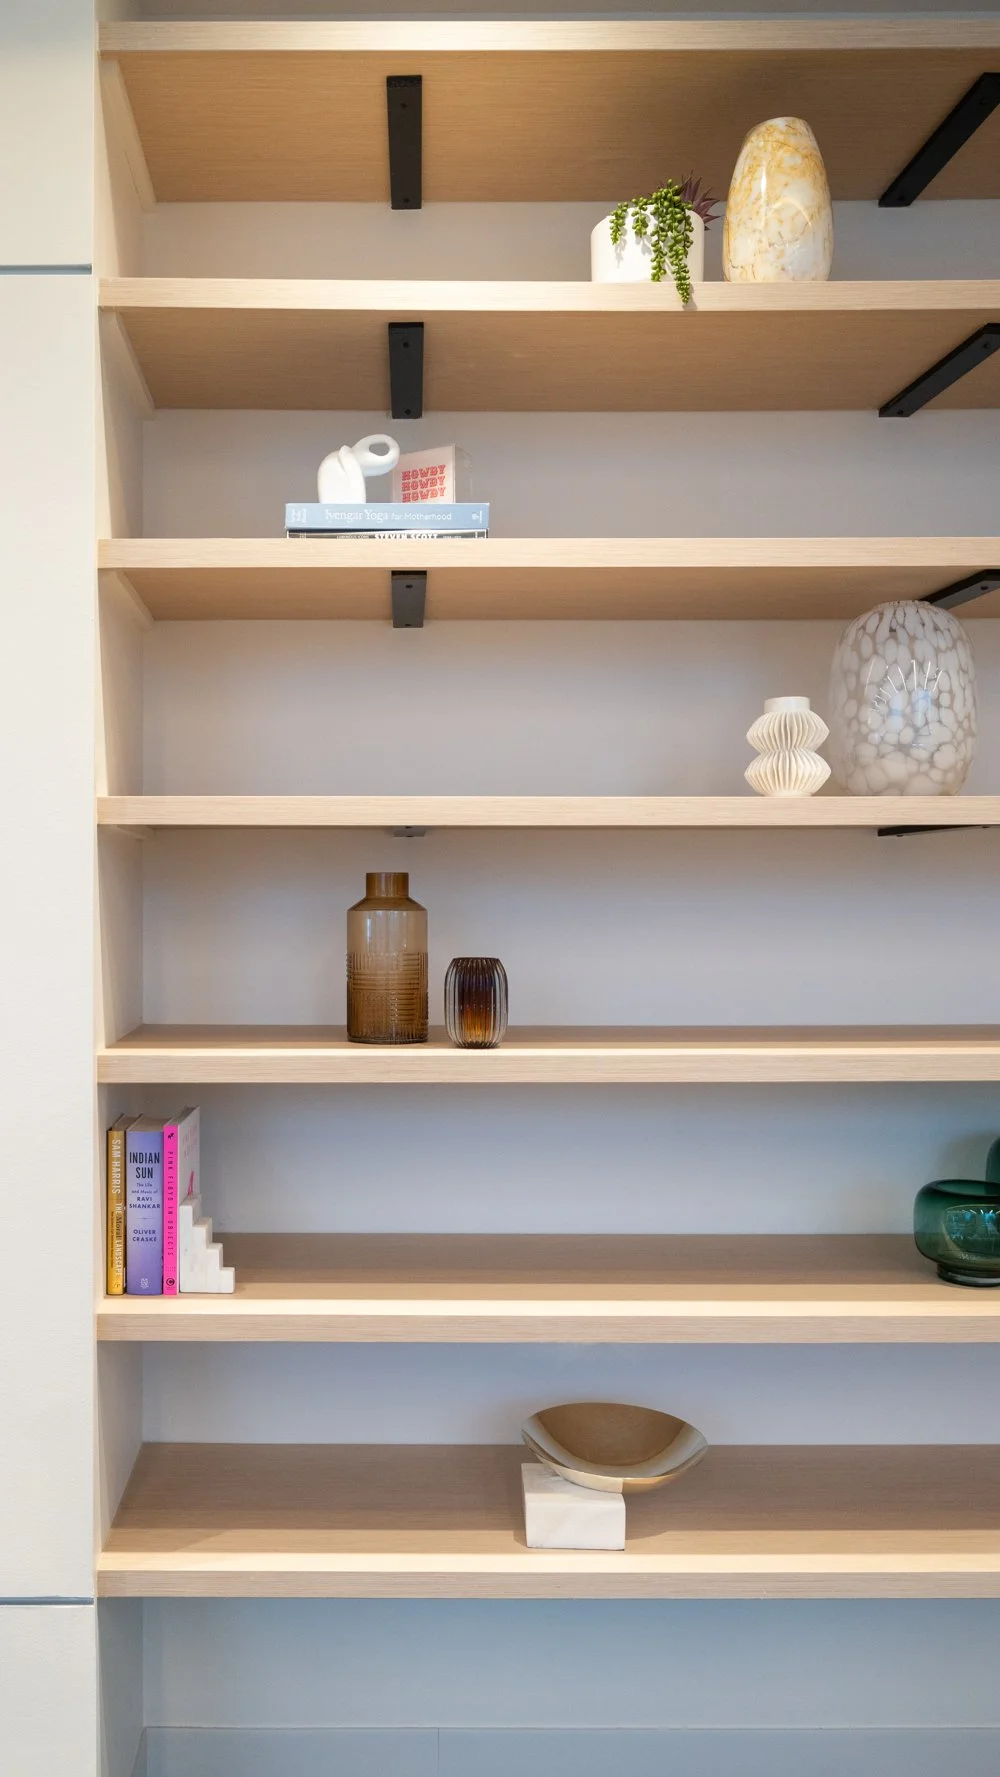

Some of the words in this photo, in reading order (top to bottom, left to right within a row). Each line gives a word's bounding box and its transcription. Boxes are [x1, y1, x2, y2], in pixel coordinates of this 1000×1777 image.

[402, 464, 446, 481] HOWDY
[401, 476, 446, 492] HOWDY
[402, 487, 446, 503] HOWDY
[325, 509, 363, 523] Iyengar
[363, 509, 389, 523] Yoga
[391, 512, 403, 520] for
[404, 511, 452, 521] Motherhood
[112, 1139, 121, 1158] SAM
[129, 1152, 160, 1164] INDIAN
[112, 1161, 121, 1194] HARRIS
[135, 1167, 153, 1179] SUN
[167, 1206, 174, 1215] IN
